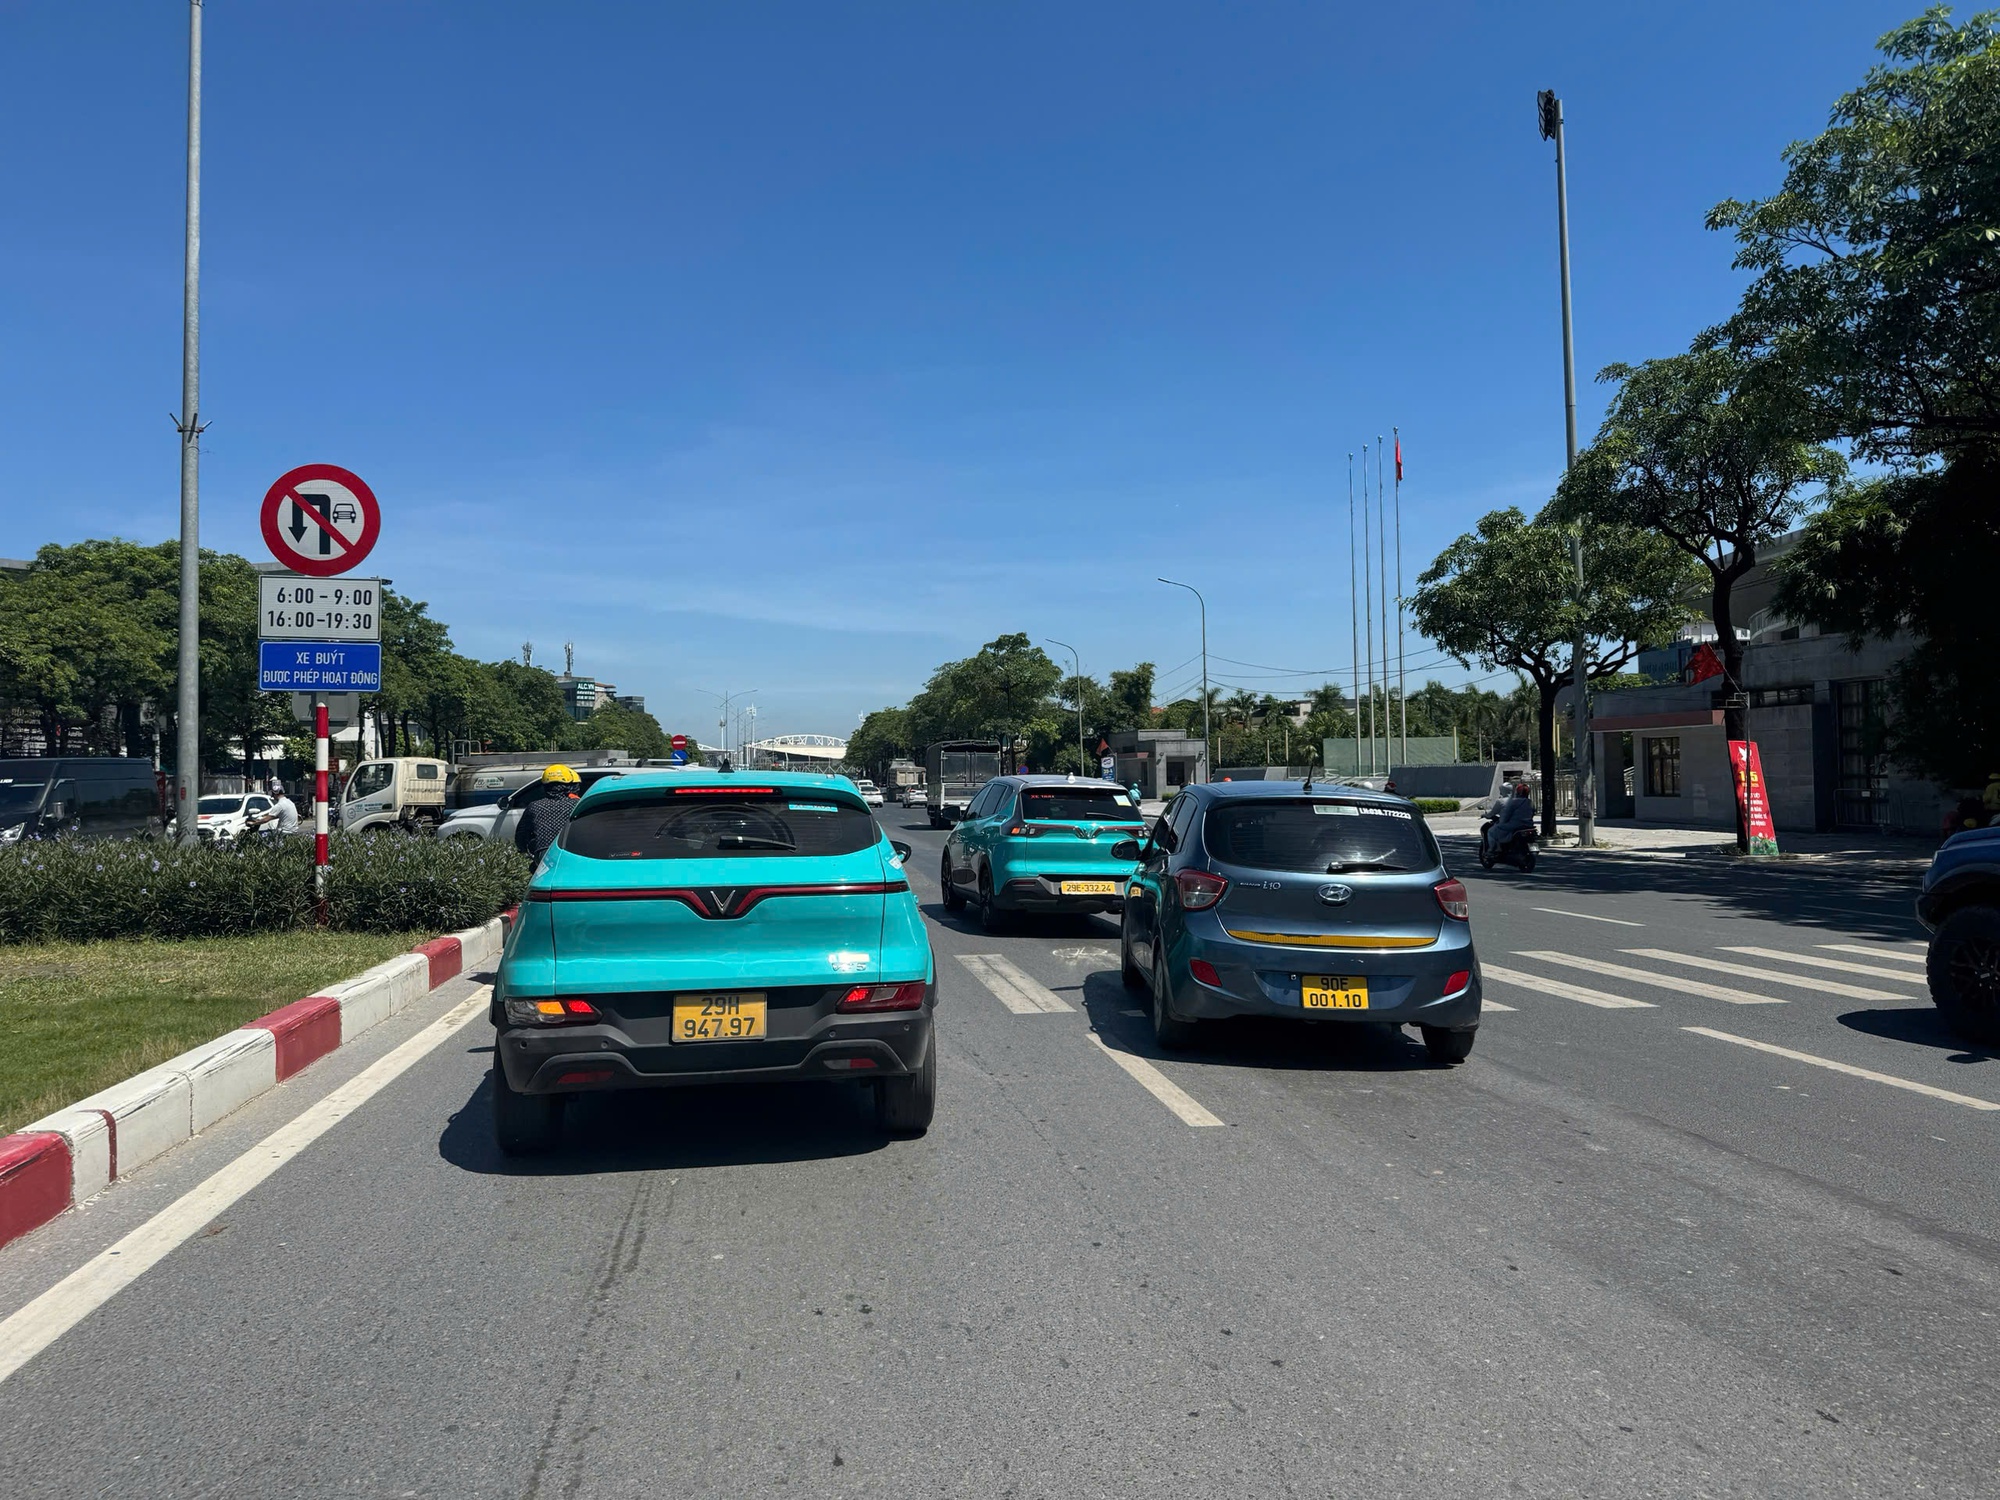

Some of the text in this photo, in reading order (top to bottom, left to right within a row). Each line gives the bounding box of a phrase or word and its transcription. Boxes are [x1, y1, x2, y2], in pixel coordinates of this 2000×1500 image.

[277, 587, 314, 604] 6:00
[334, 589, 372, 605] 9:00
[296, 649, 345, 665] XE BUÝT
[263, 668, 378, 686] ĐƯỢC PHÉP HOẠT ĐỘNG
[1066, 884, 1112, 893] 29E-332.24
[1320, 977, 1349, 992] 90E
[701, 995, 740, 1016] 29H
[1309, 993, 1362, 1008] 001.10
[684, 1016, 756, 1038] 947.97
